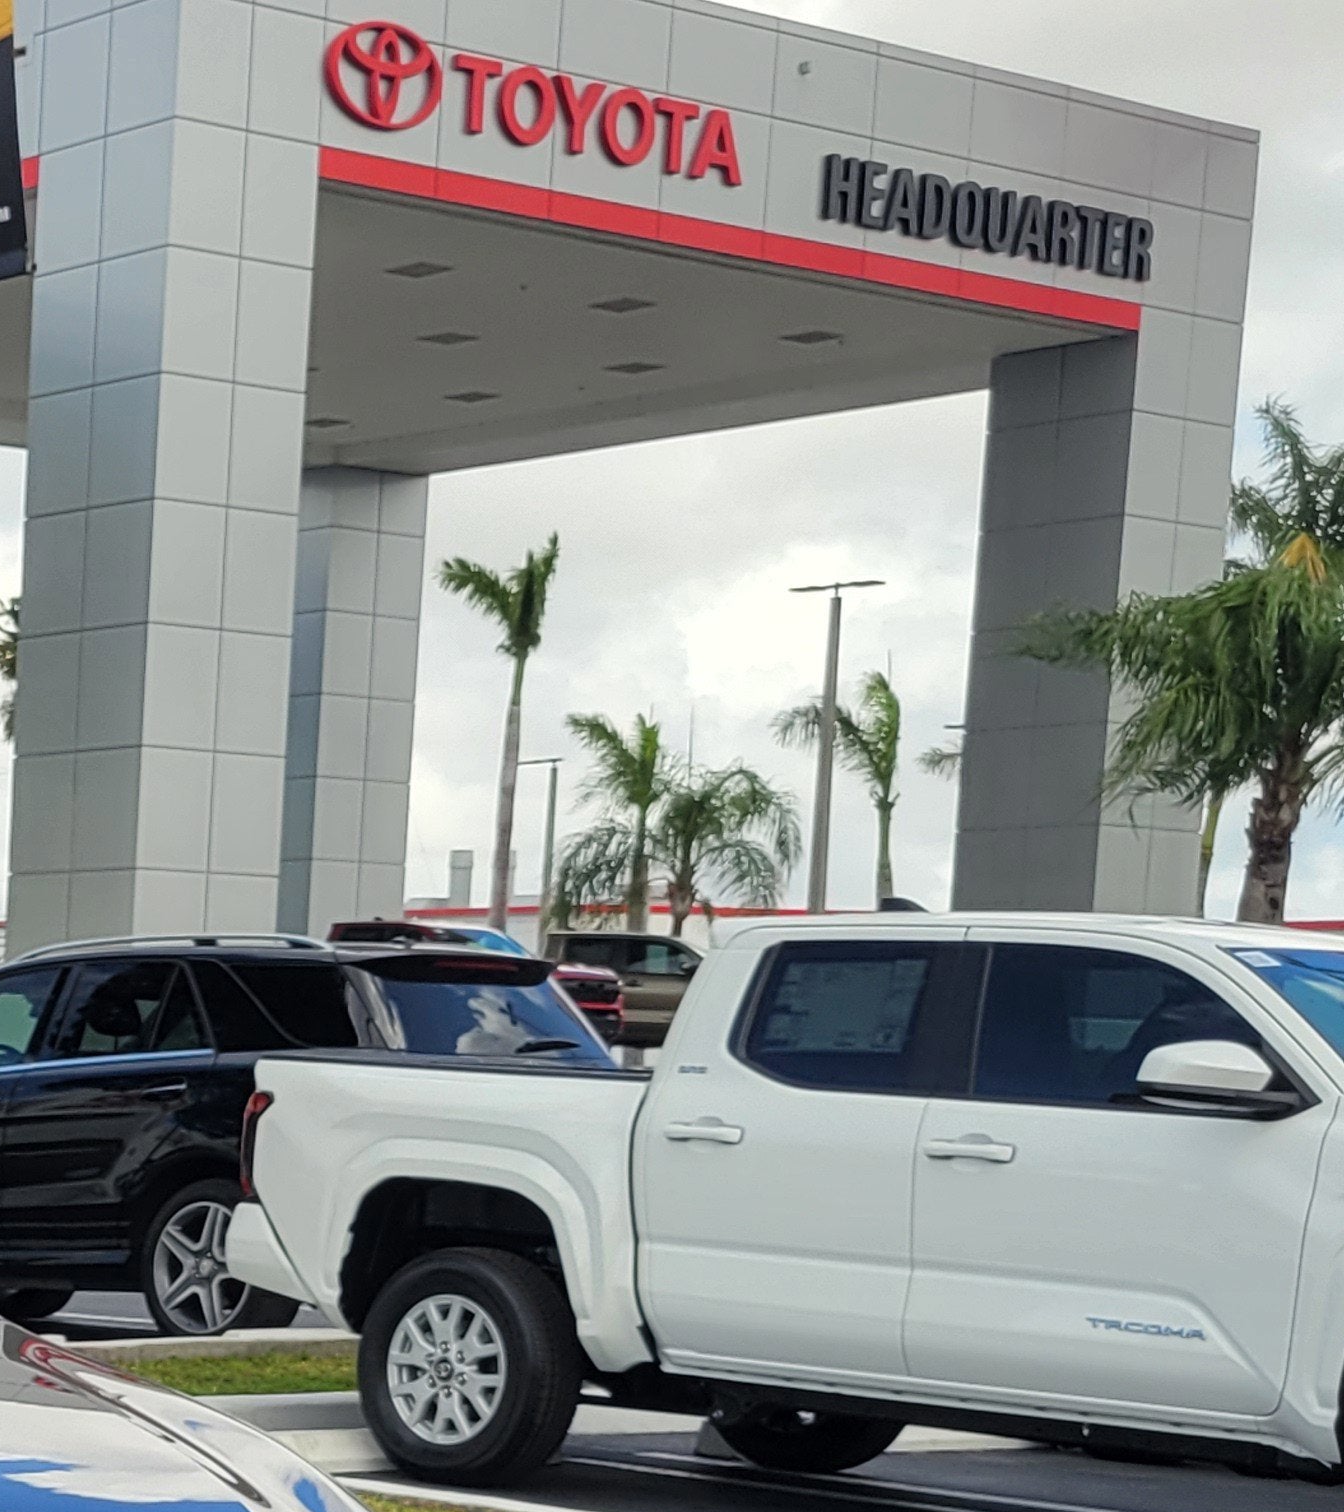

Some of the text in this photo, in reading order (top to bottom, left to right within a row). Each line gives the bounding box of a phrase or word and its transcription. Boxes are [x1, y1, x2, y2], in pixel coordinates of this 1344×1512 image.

[452, 53, 1155, 283] TOYOTA HEADQUARTER
[1085, 1316, 1207, 1341] TACOMA
